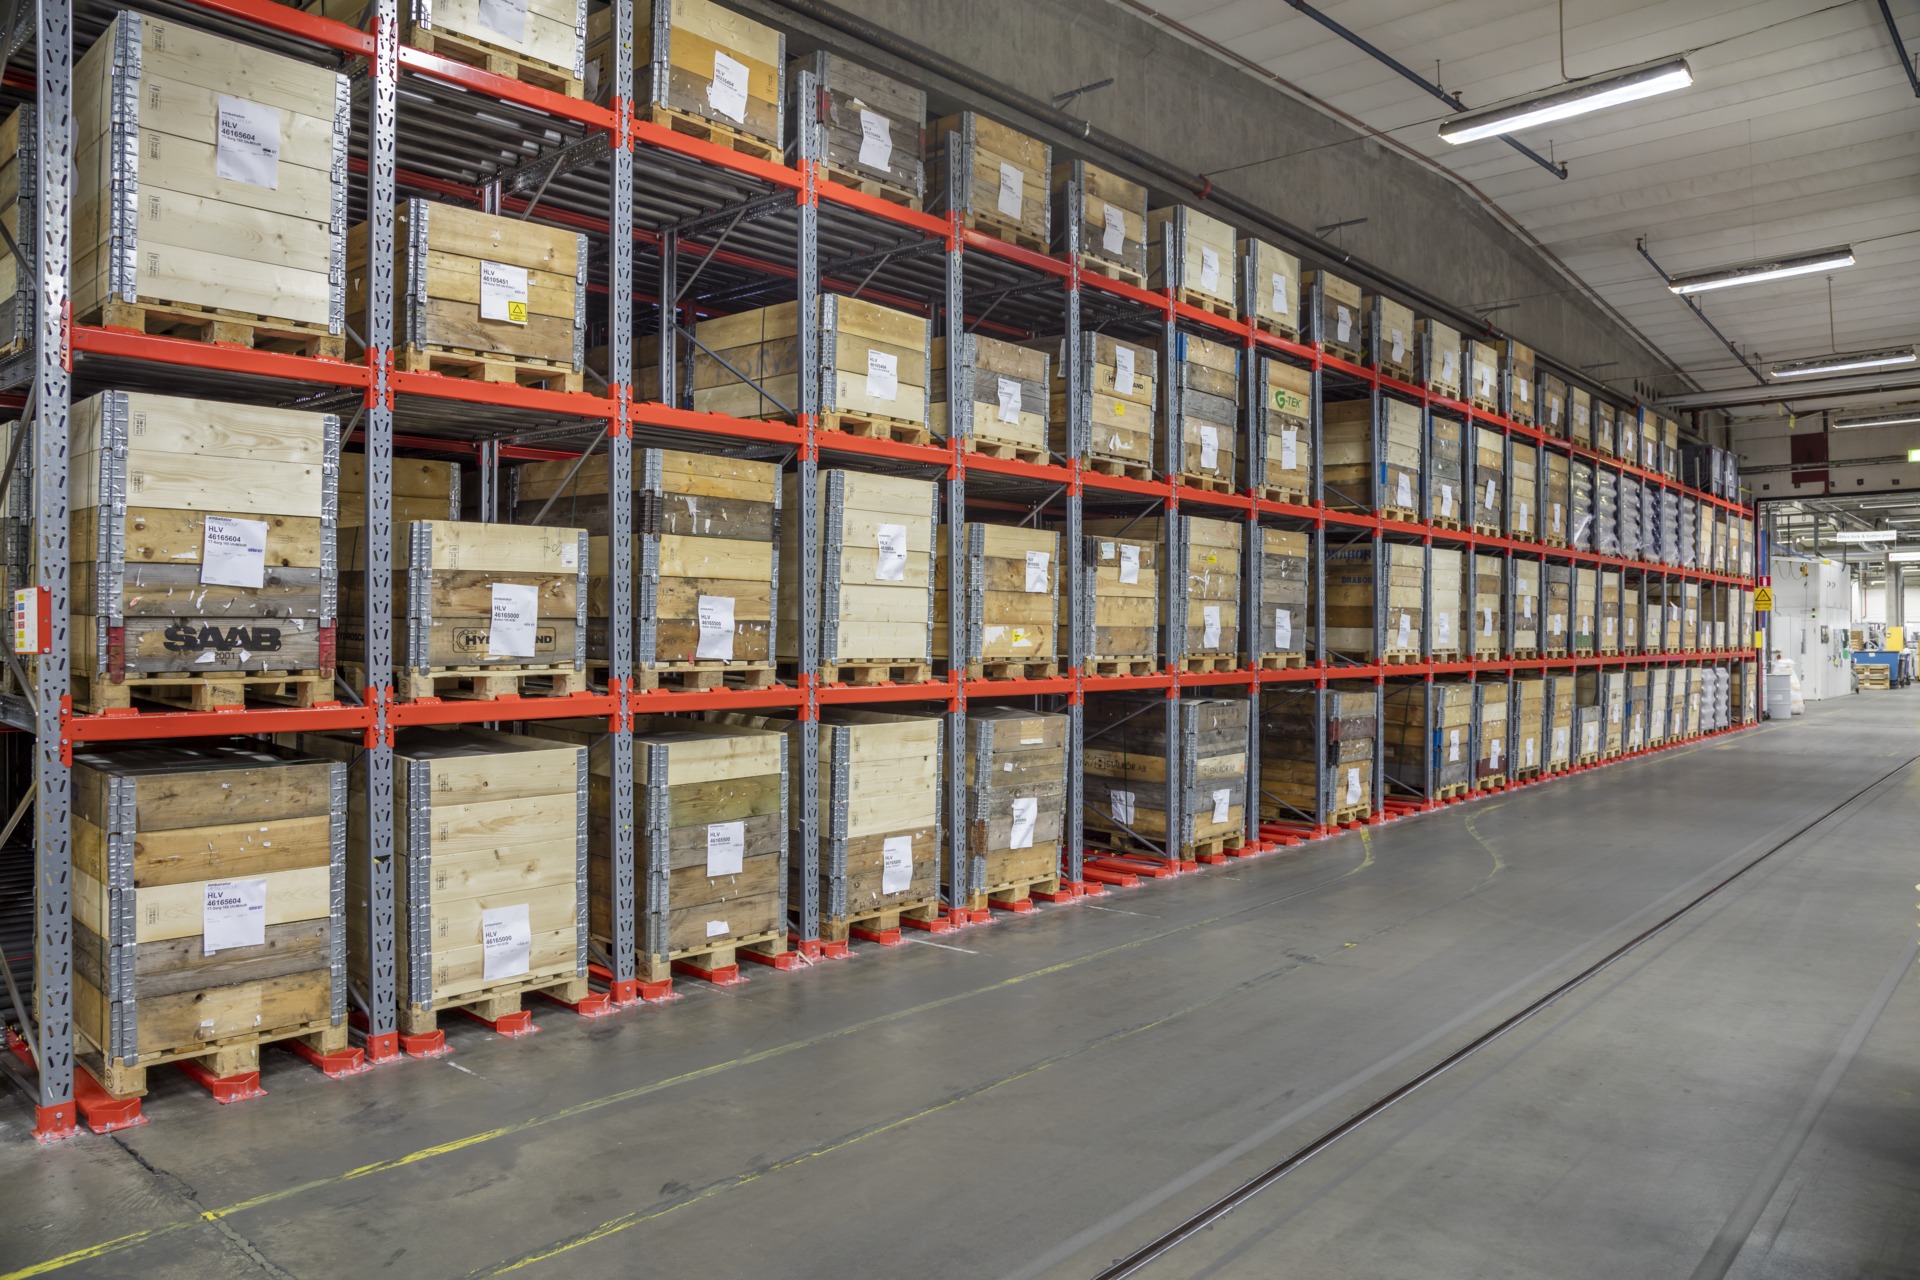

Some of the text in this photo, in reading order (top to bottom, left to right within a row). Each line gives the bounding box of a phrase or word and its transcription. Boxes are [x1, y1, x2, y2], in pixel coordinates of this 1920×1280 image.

[222, 119, 237, 129] HLV
[221, 129, 256, 141] 46165604
[483, 268, 495, 276] HLV
[208, 525, 223, 534] HLV
[207, 533, 241, 543] 46165604
[163, 625, 282, 651] SAAB
[215, 651, 235, 660] 2001
[207, 897, 241, 907] 46165604
